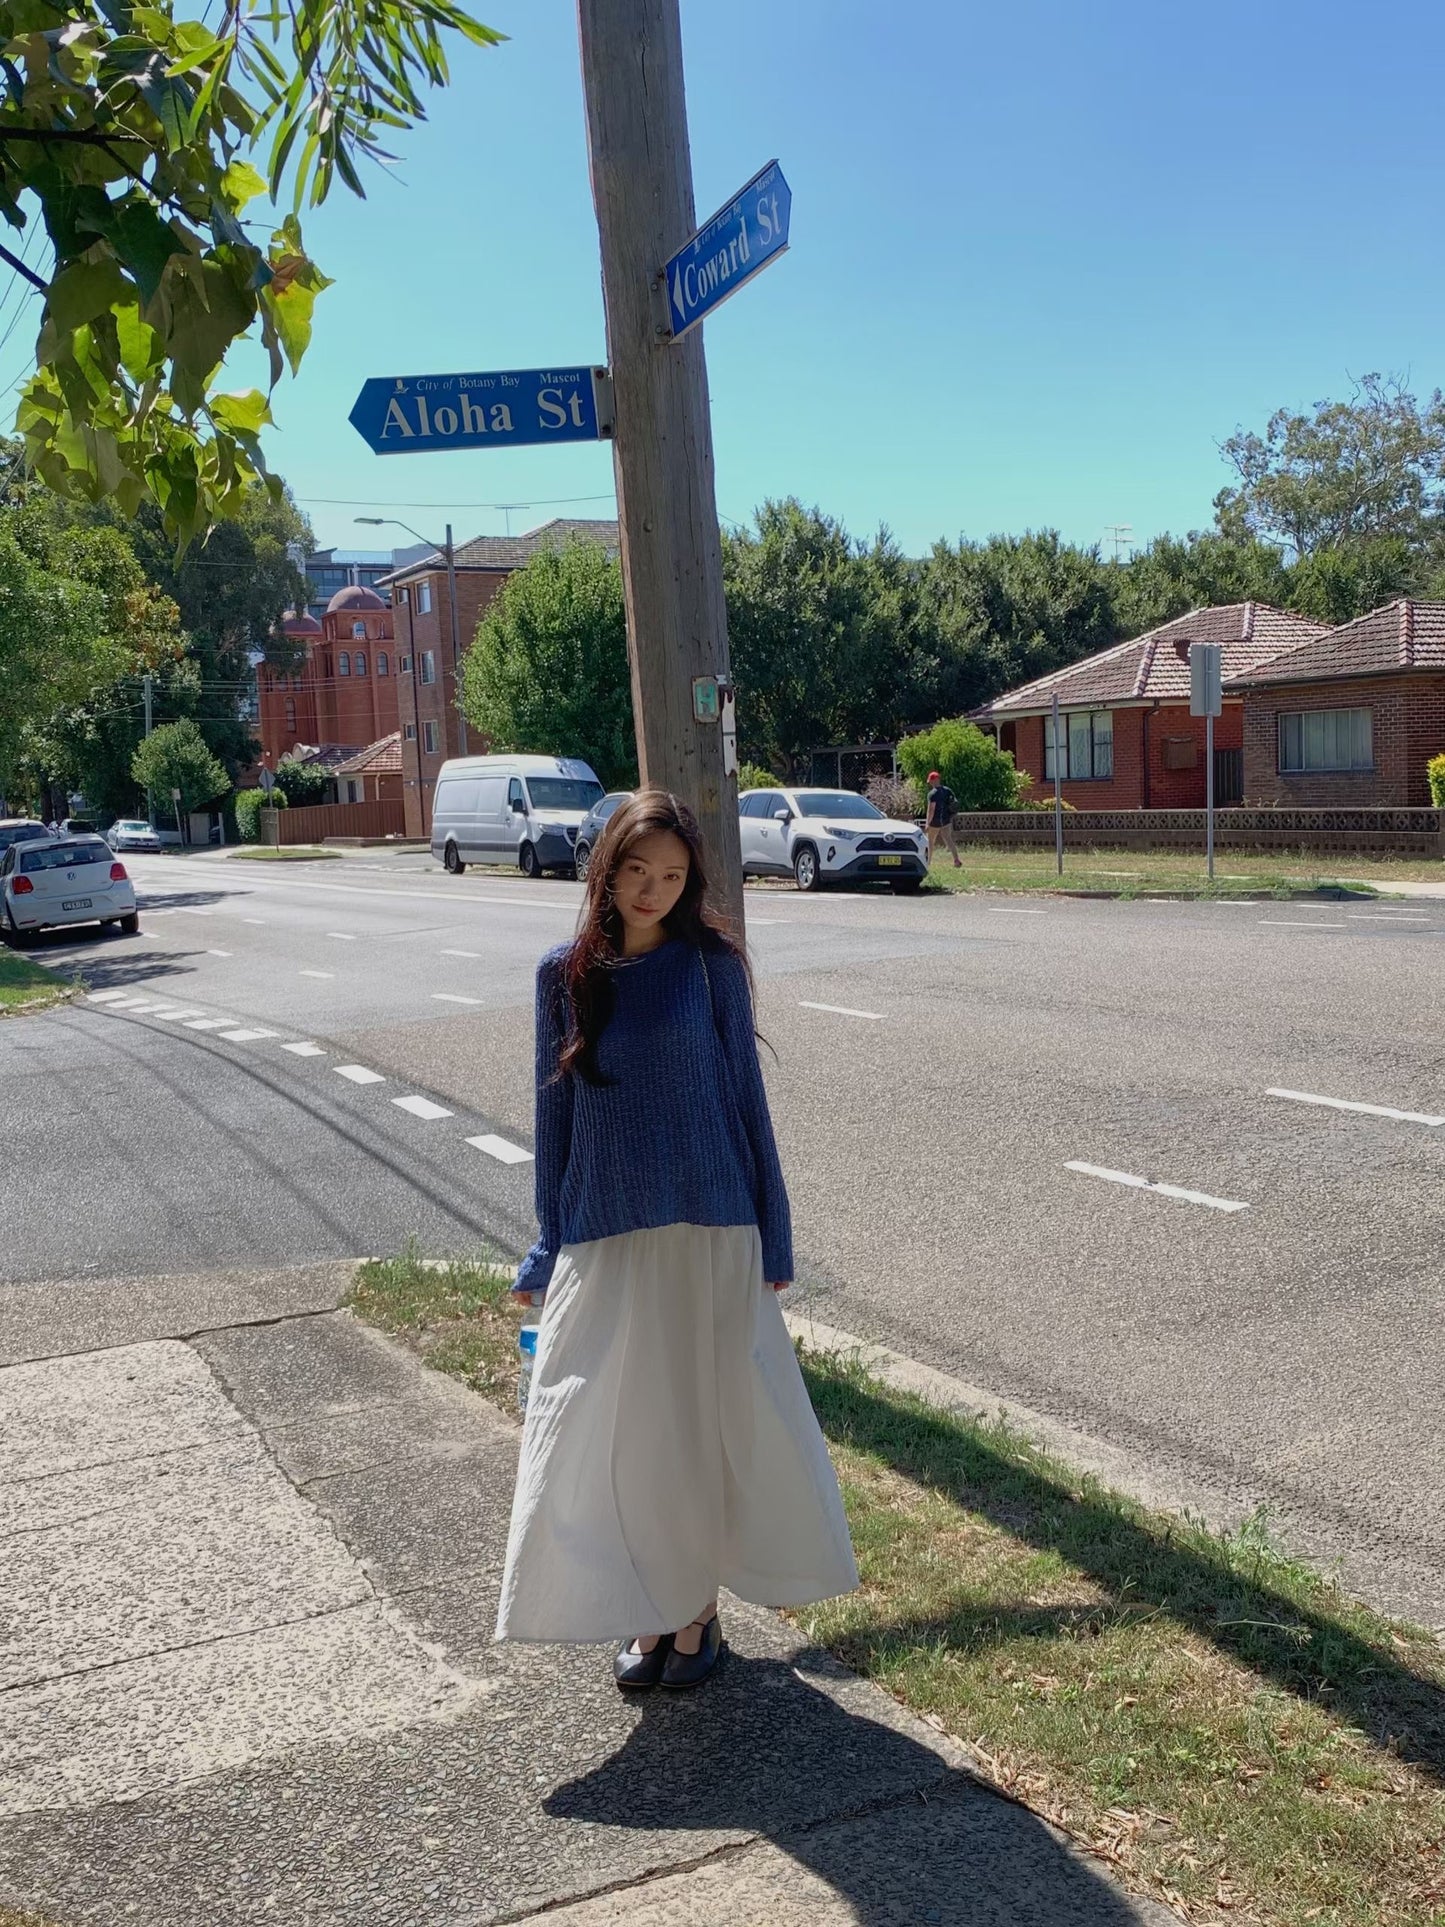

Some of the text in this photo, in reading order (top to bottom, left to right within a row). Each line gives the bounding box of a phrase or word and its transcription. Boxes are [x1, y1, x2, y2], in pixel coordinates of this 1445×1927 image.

[684, 216, 750, 307] Coward
[756, 191, 781, 246] St
[416, 373, 580, 391] City of Botany Bay Mascot
[379, 388, 586, 439] Aloha St
